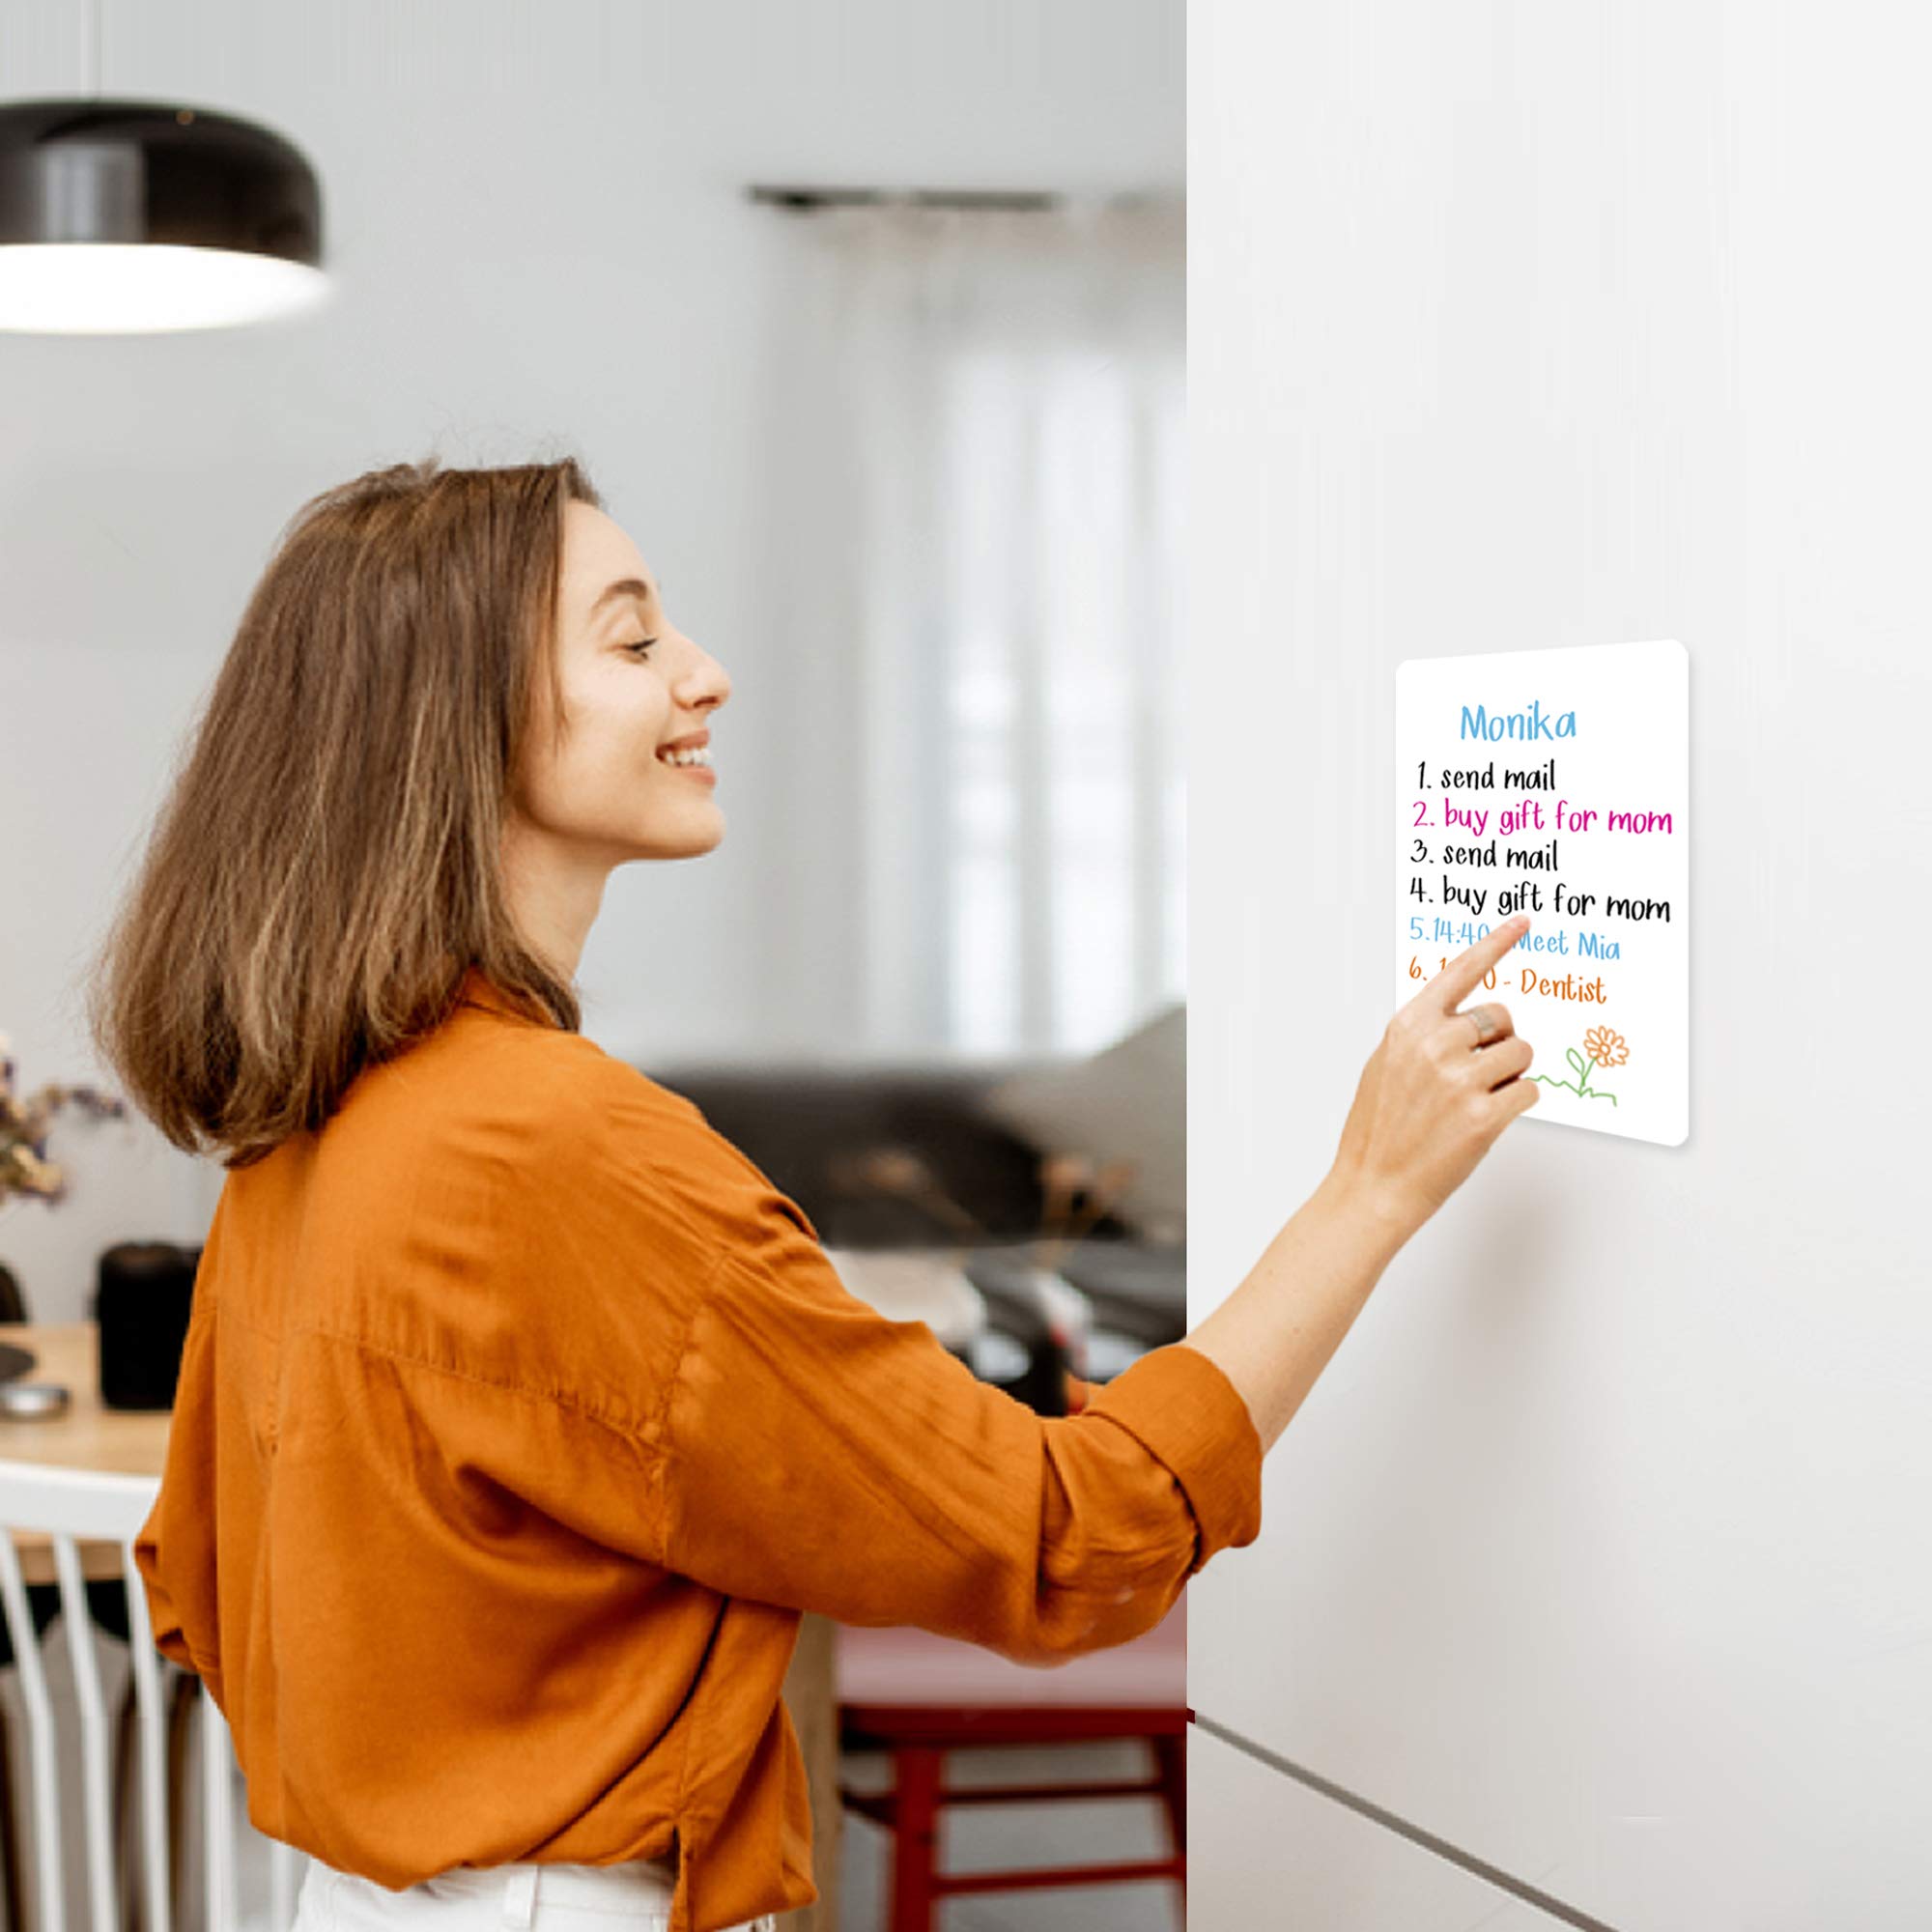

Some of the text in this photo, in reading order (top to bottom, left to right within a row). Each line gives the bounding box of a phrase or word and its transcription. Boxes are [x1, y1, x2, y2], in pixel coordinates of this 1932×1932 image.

[1460, 699, 1577, 743] Monika
[1417, 757, 1556, 792] 1. send mail
[1412, 796, 1673, 838] 2. buy gift for mom
[1409, 838, 1559, 872] 3. send mail
[1409, 873, 1671, 923] 4. buy gift for mom
[1577, 931, 1621, 960] Mia
[1408, 955, 1428, 981] 6.
[1520, 968, 1607, 1006] Dentist
